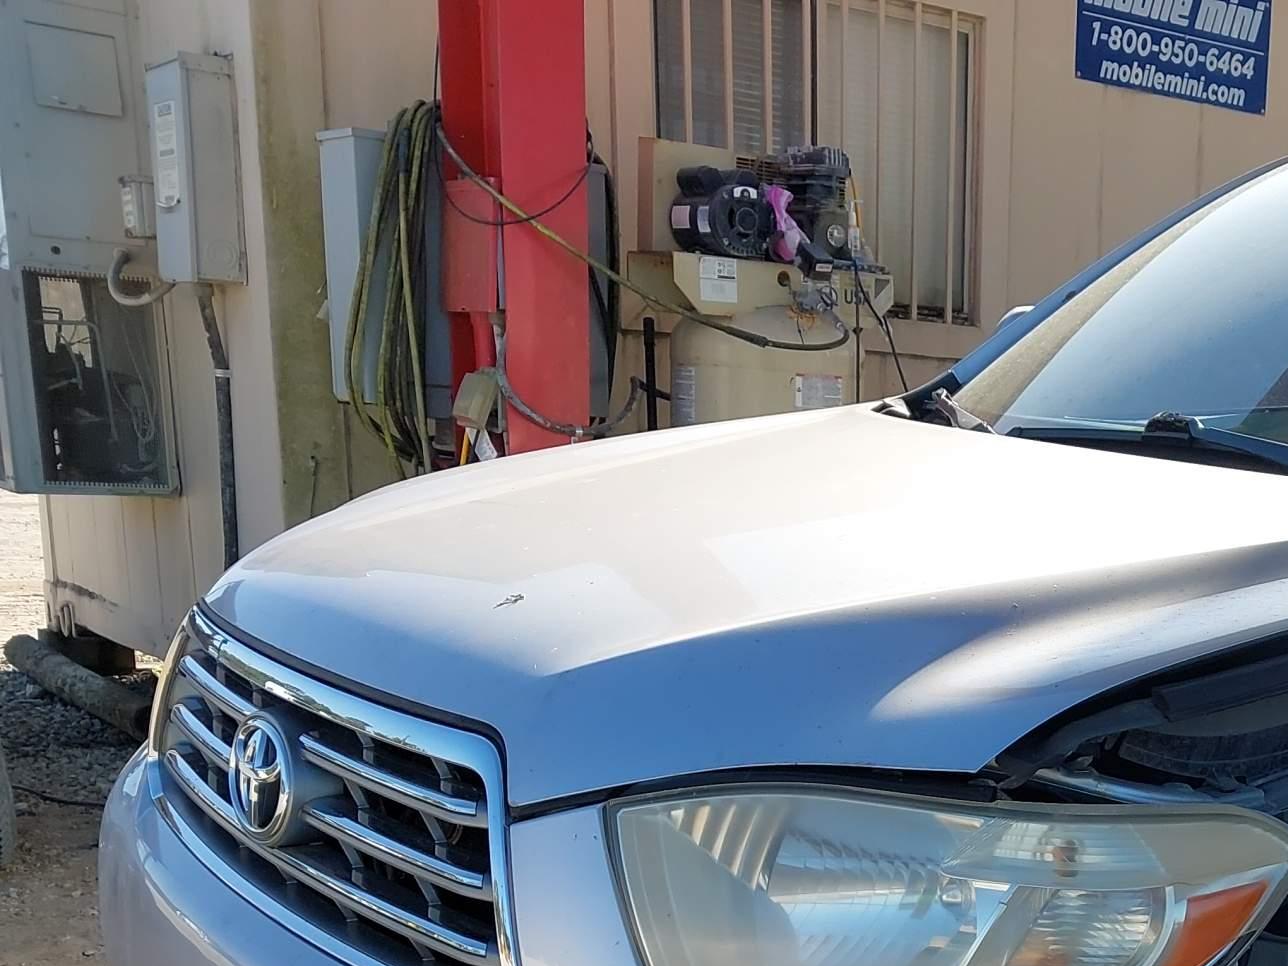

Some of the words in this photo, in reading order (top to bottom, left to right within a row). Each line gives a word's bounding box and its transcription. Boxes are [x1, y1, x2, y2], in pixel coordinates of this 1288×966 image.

[1194, 0, 1266, 43] mini
[1091, 21, 1255, 79] 1-800-950-6464
[1100, 60, 1246, 106] mobilemini.com
